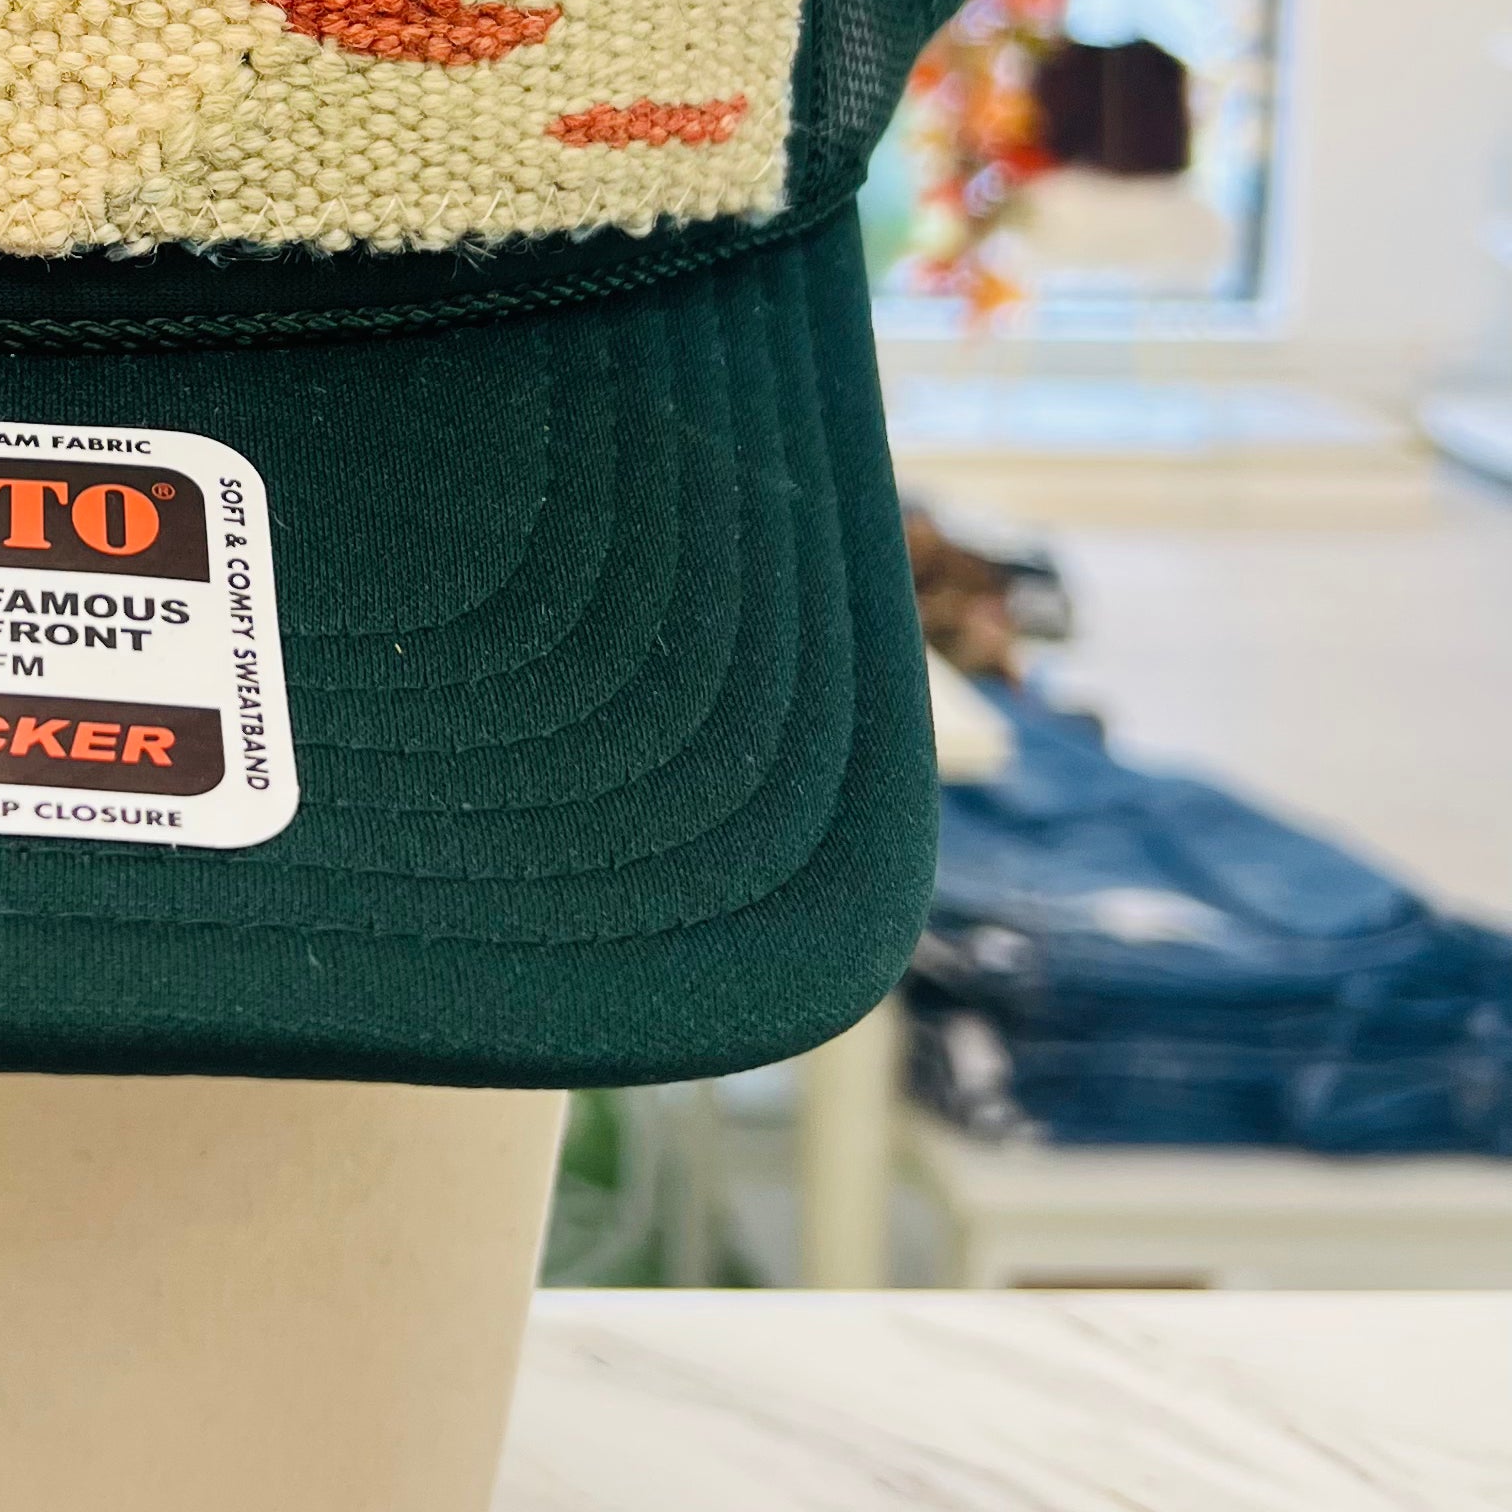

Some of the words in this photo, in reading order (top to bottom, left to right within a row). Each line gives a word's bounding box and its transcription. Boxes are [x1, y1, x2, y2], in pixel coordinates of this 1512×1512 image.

[51, 435, 151, 455] FABRIC
[219, 477, 246, 527] SOFT
[224, 533, 248, 548] &
[226, 558, 255, 641] COMFY
[233, 648, 270, 791] SWEATBAND
[34, 803, 183, 828] CLOSURE
